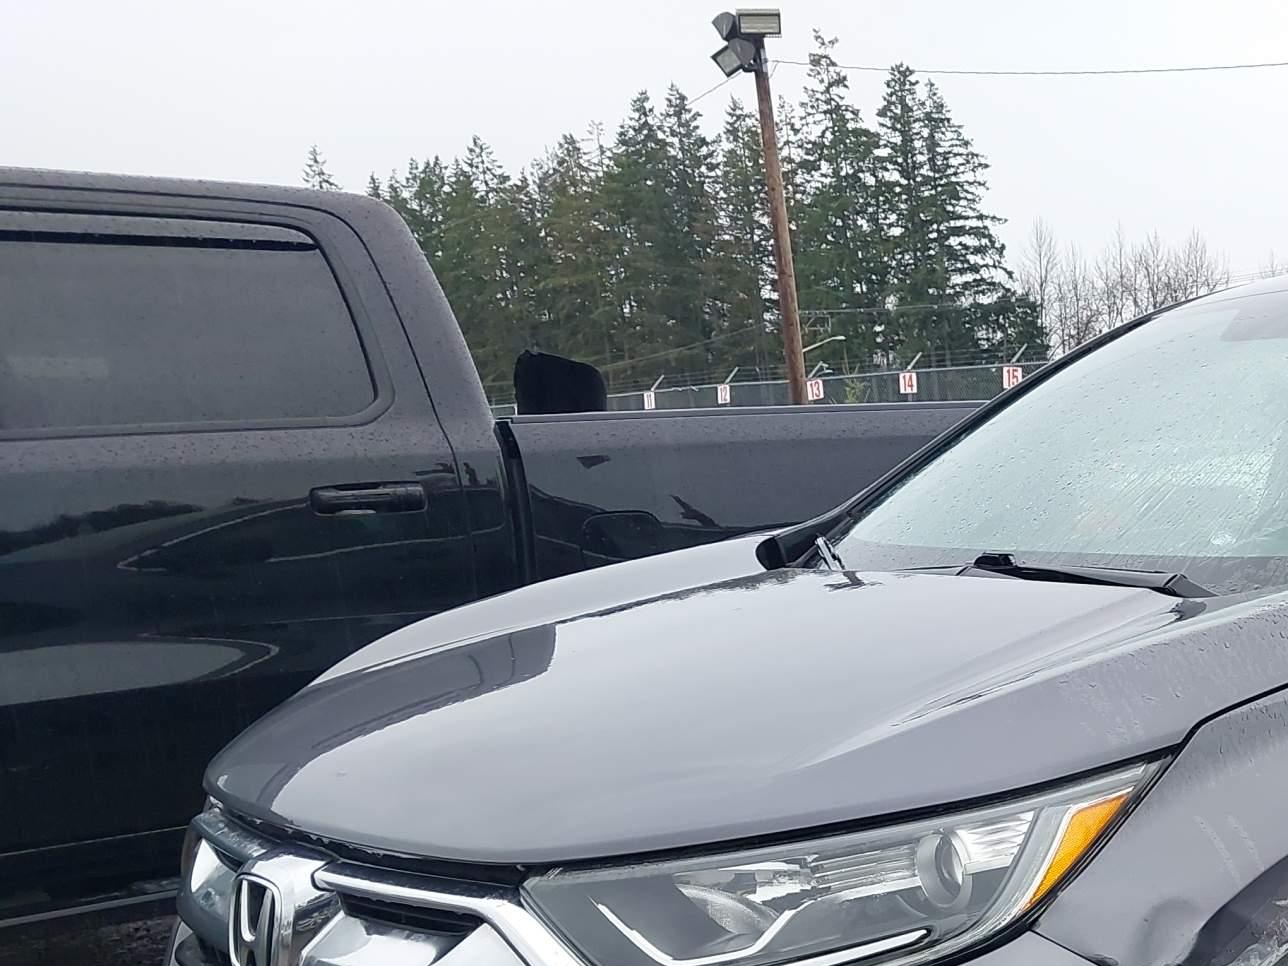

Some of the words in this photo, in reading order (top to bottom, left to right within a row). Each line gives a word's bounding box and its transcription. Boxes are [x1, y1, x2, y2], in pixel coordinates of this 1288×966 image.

[902, 374, 915, 391] 14
[1005, 368, 1020, 387] 15
[719, 385, 729, 403] 12
[809, 381, 821, 399] 13
[646, 394, 654, 409] 11
